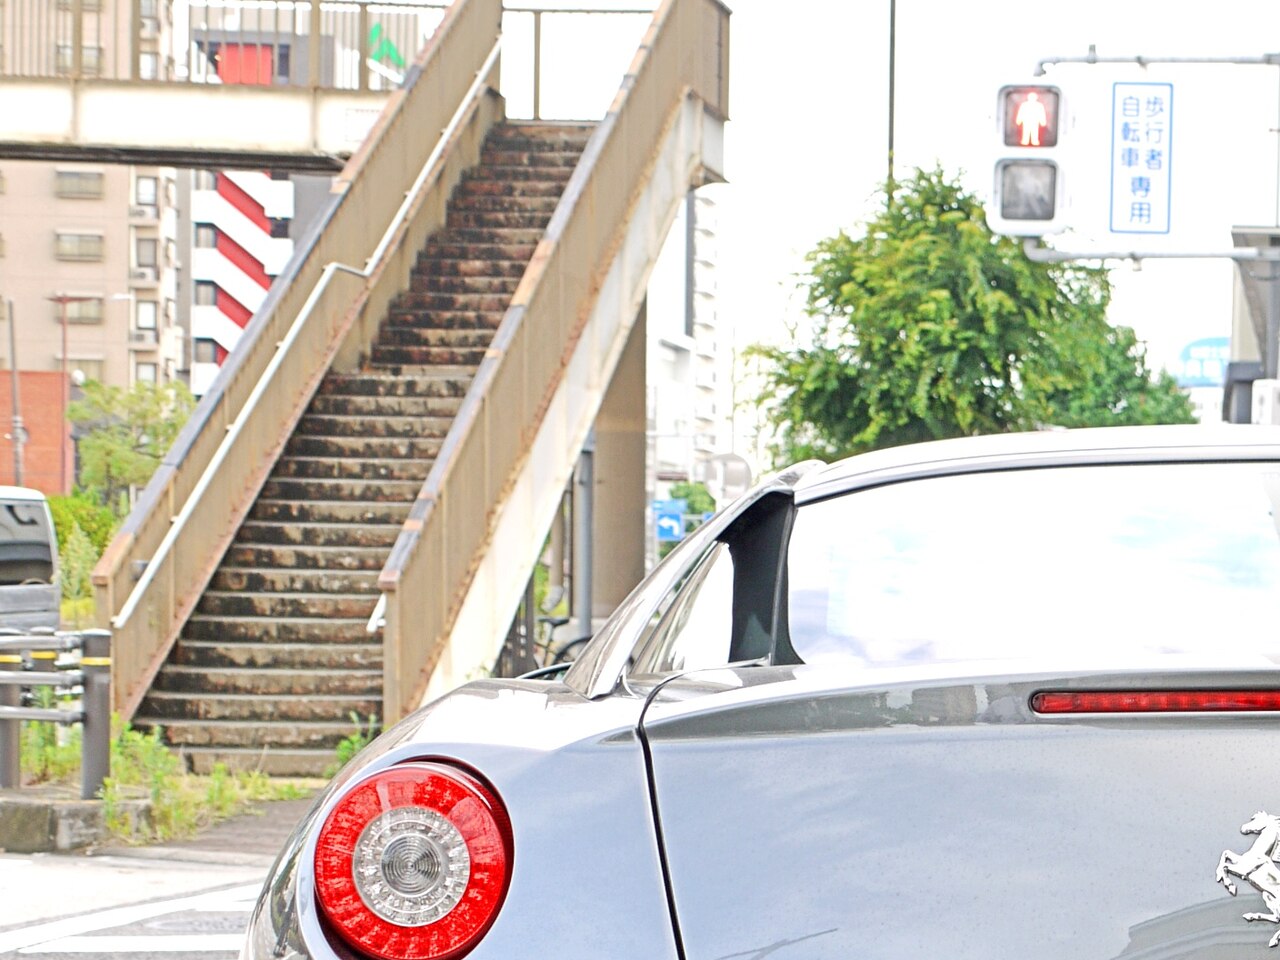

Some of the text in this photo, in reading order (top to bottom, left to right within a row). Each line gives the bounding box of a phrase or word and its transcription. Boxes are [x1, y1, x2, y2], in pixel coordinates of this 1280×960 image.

[1122, 96, 1140, 168] 自転車
[1146, 96, 1164, 170] 歩行者
[1130, 176, 1151, 224] 専用
